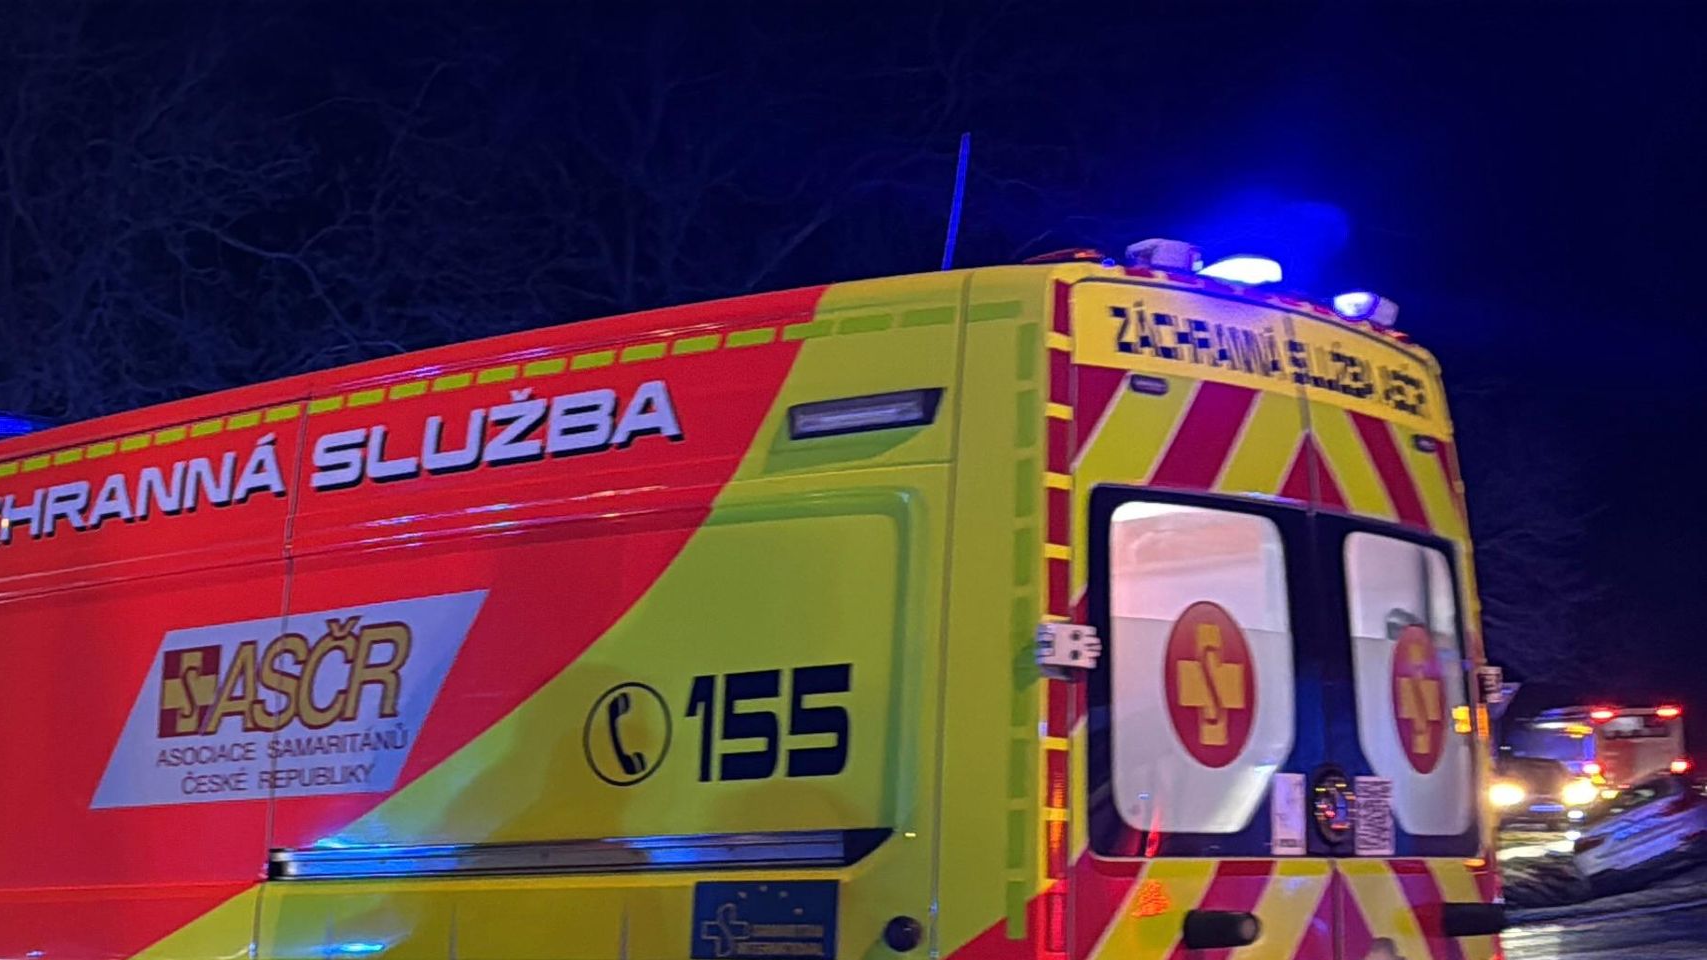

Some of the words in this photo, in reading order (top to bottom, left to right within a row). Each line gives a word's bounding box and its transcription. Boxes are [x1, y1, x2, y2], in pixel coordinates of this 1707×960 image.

[310, 379, 684, 494] SLUŽBA
[201, 616, 413, 736] ASČR
[684, 662, 854, 782] 155
[157, 742, 256, 768] ASOCIACE
[268, 723, 409, 759] SAMARITÁNŮ
[182, 771, 247, 795] ČESKÉ
[259, 764, 376, 790] REPUBLIKY
